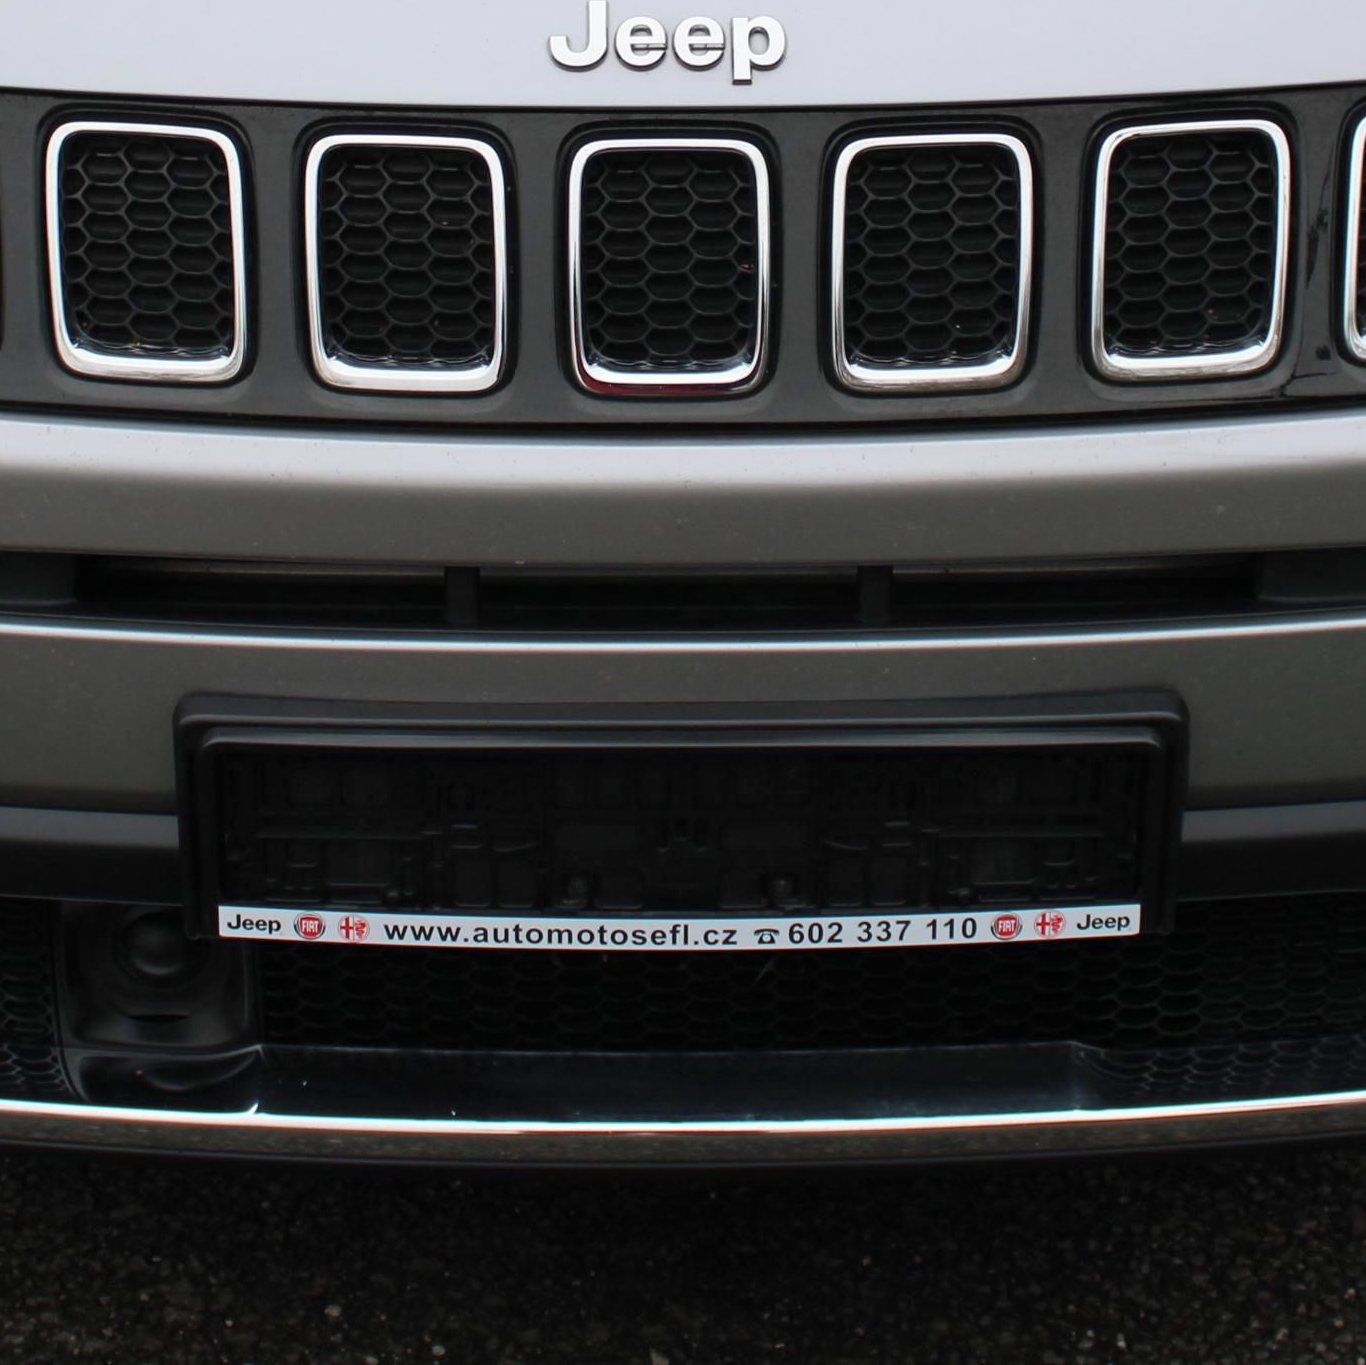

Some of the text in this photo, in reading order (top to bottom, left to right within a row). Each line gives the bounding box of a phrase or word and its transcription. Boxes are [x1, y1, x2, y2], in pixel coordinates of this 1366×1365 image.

[226, 913, 282, 935] Jeep
[383, 923, 738, 946] www.automotosefl.cz
[788, 922, 843, 944] 602
[857, 920, 911, 942] 337
[926, 917, 977, 940] 110
[1076, 913, 1131, 932] Jeep
